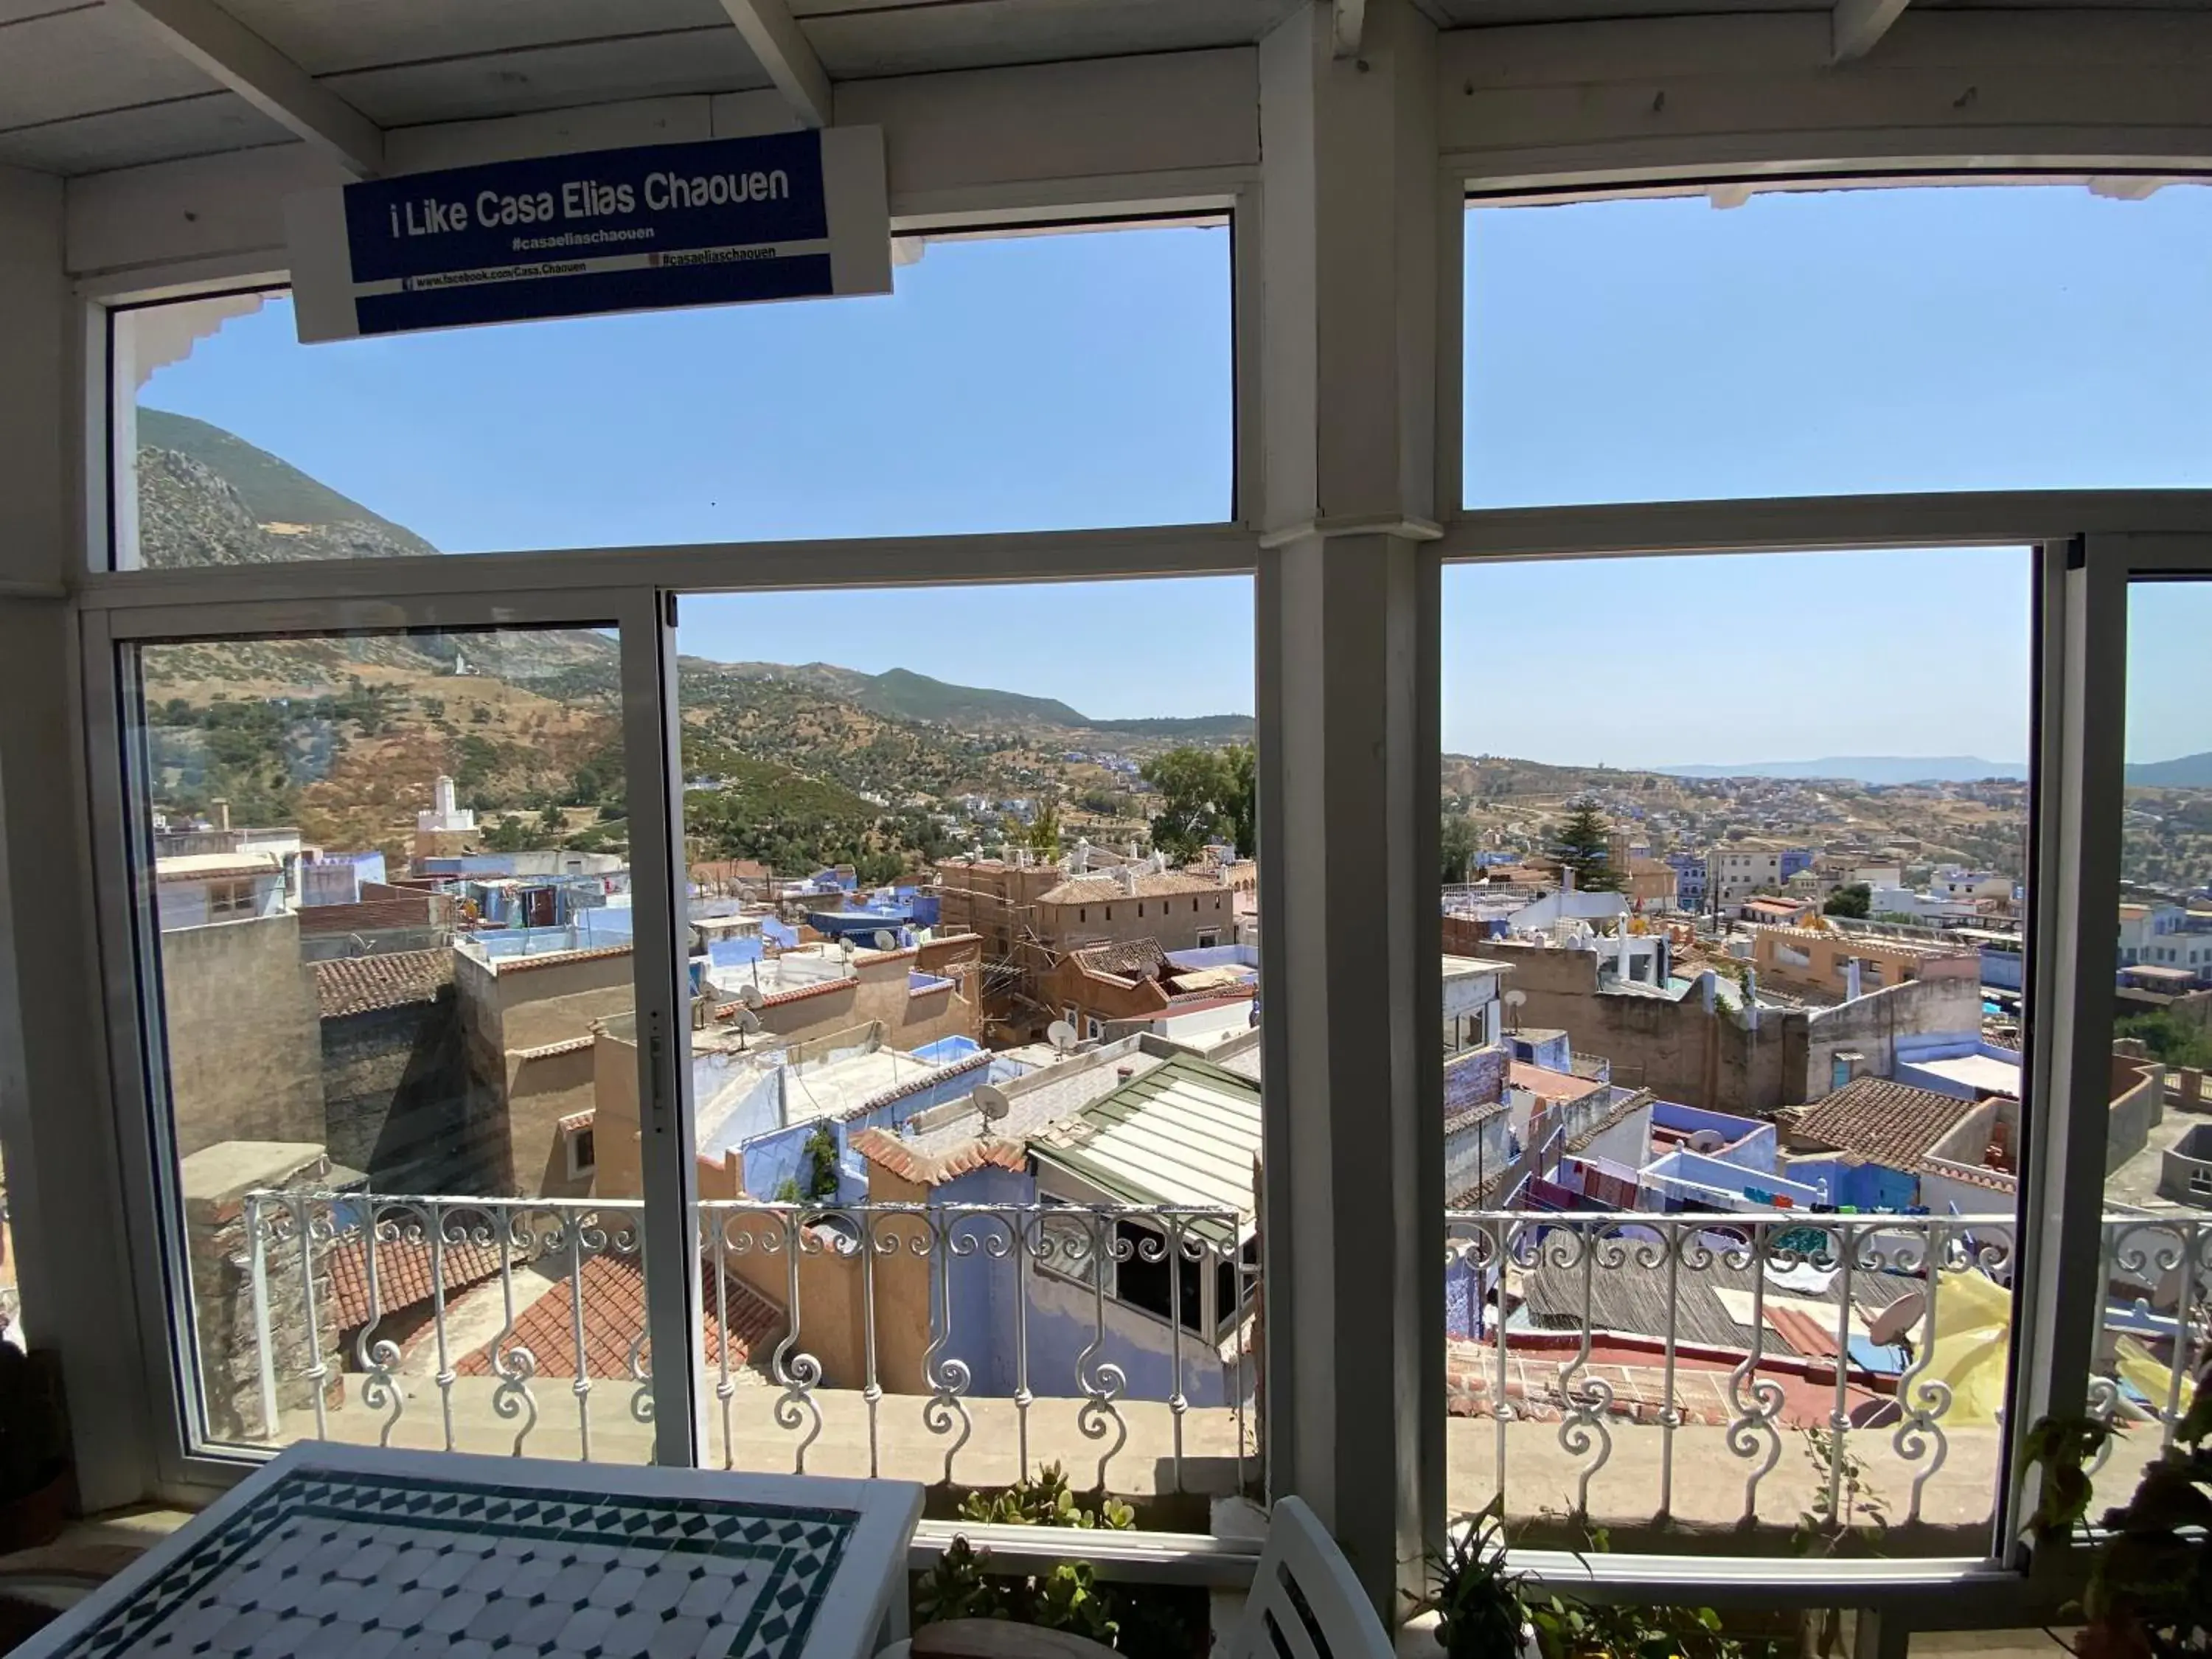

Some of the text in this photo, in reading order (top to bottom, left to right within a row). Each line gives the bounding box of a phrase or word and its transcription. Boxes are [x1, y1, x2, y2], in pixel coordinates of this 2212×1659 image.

[390, 170, 789, 237] i Like Casa Elias Chaouen
[512, 226, 655, 251] #casaeliaschaouen
[663, 246, 776, 266] #casaeliaschaouen
